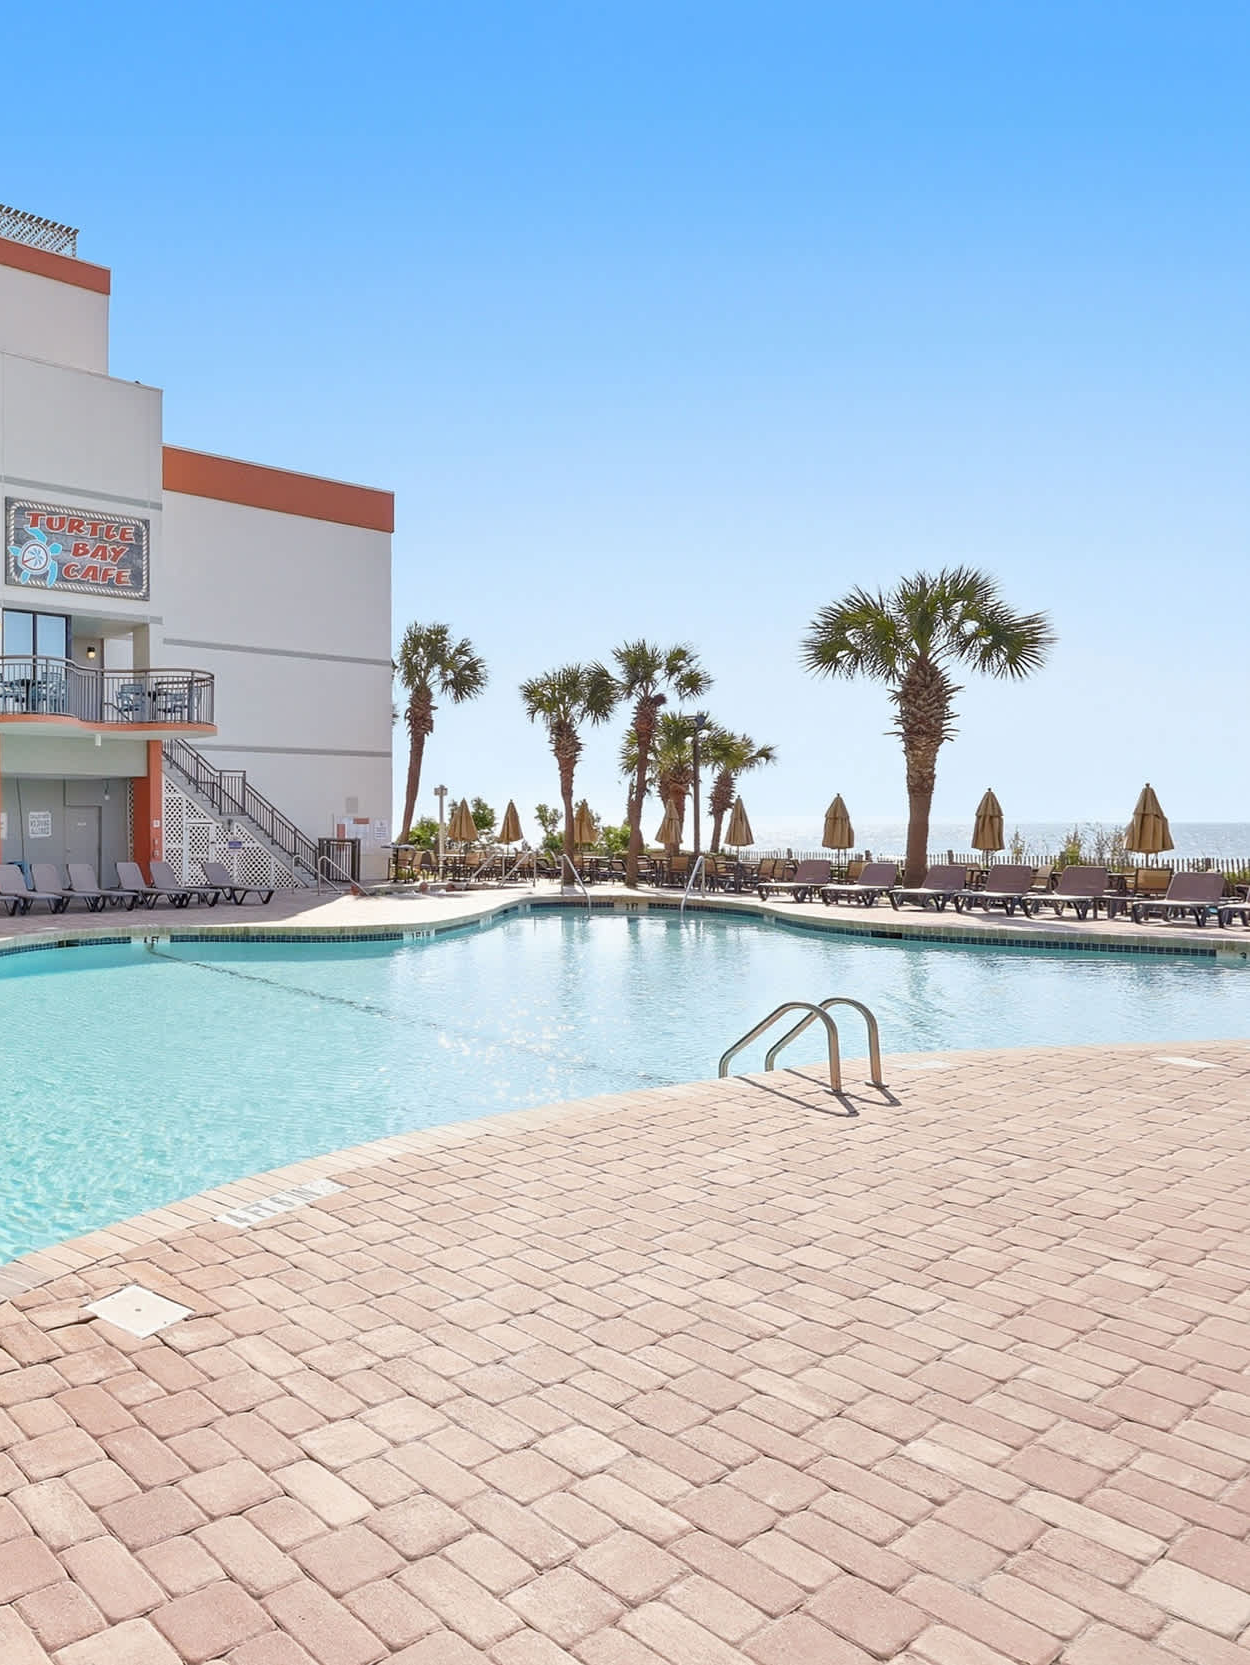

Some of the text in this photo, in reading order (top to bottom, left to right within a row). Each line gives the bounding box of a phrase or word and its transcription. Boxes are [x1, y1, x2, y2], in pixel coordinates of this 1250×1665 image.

[25, 511, 135, 543] TURTLE
[71, 541, 129, 565] BAY
[62, 562, 133, 587] CAFE
[240, 1202, 278, 1218] FT
[269, 1196, 295, 1208] 6
